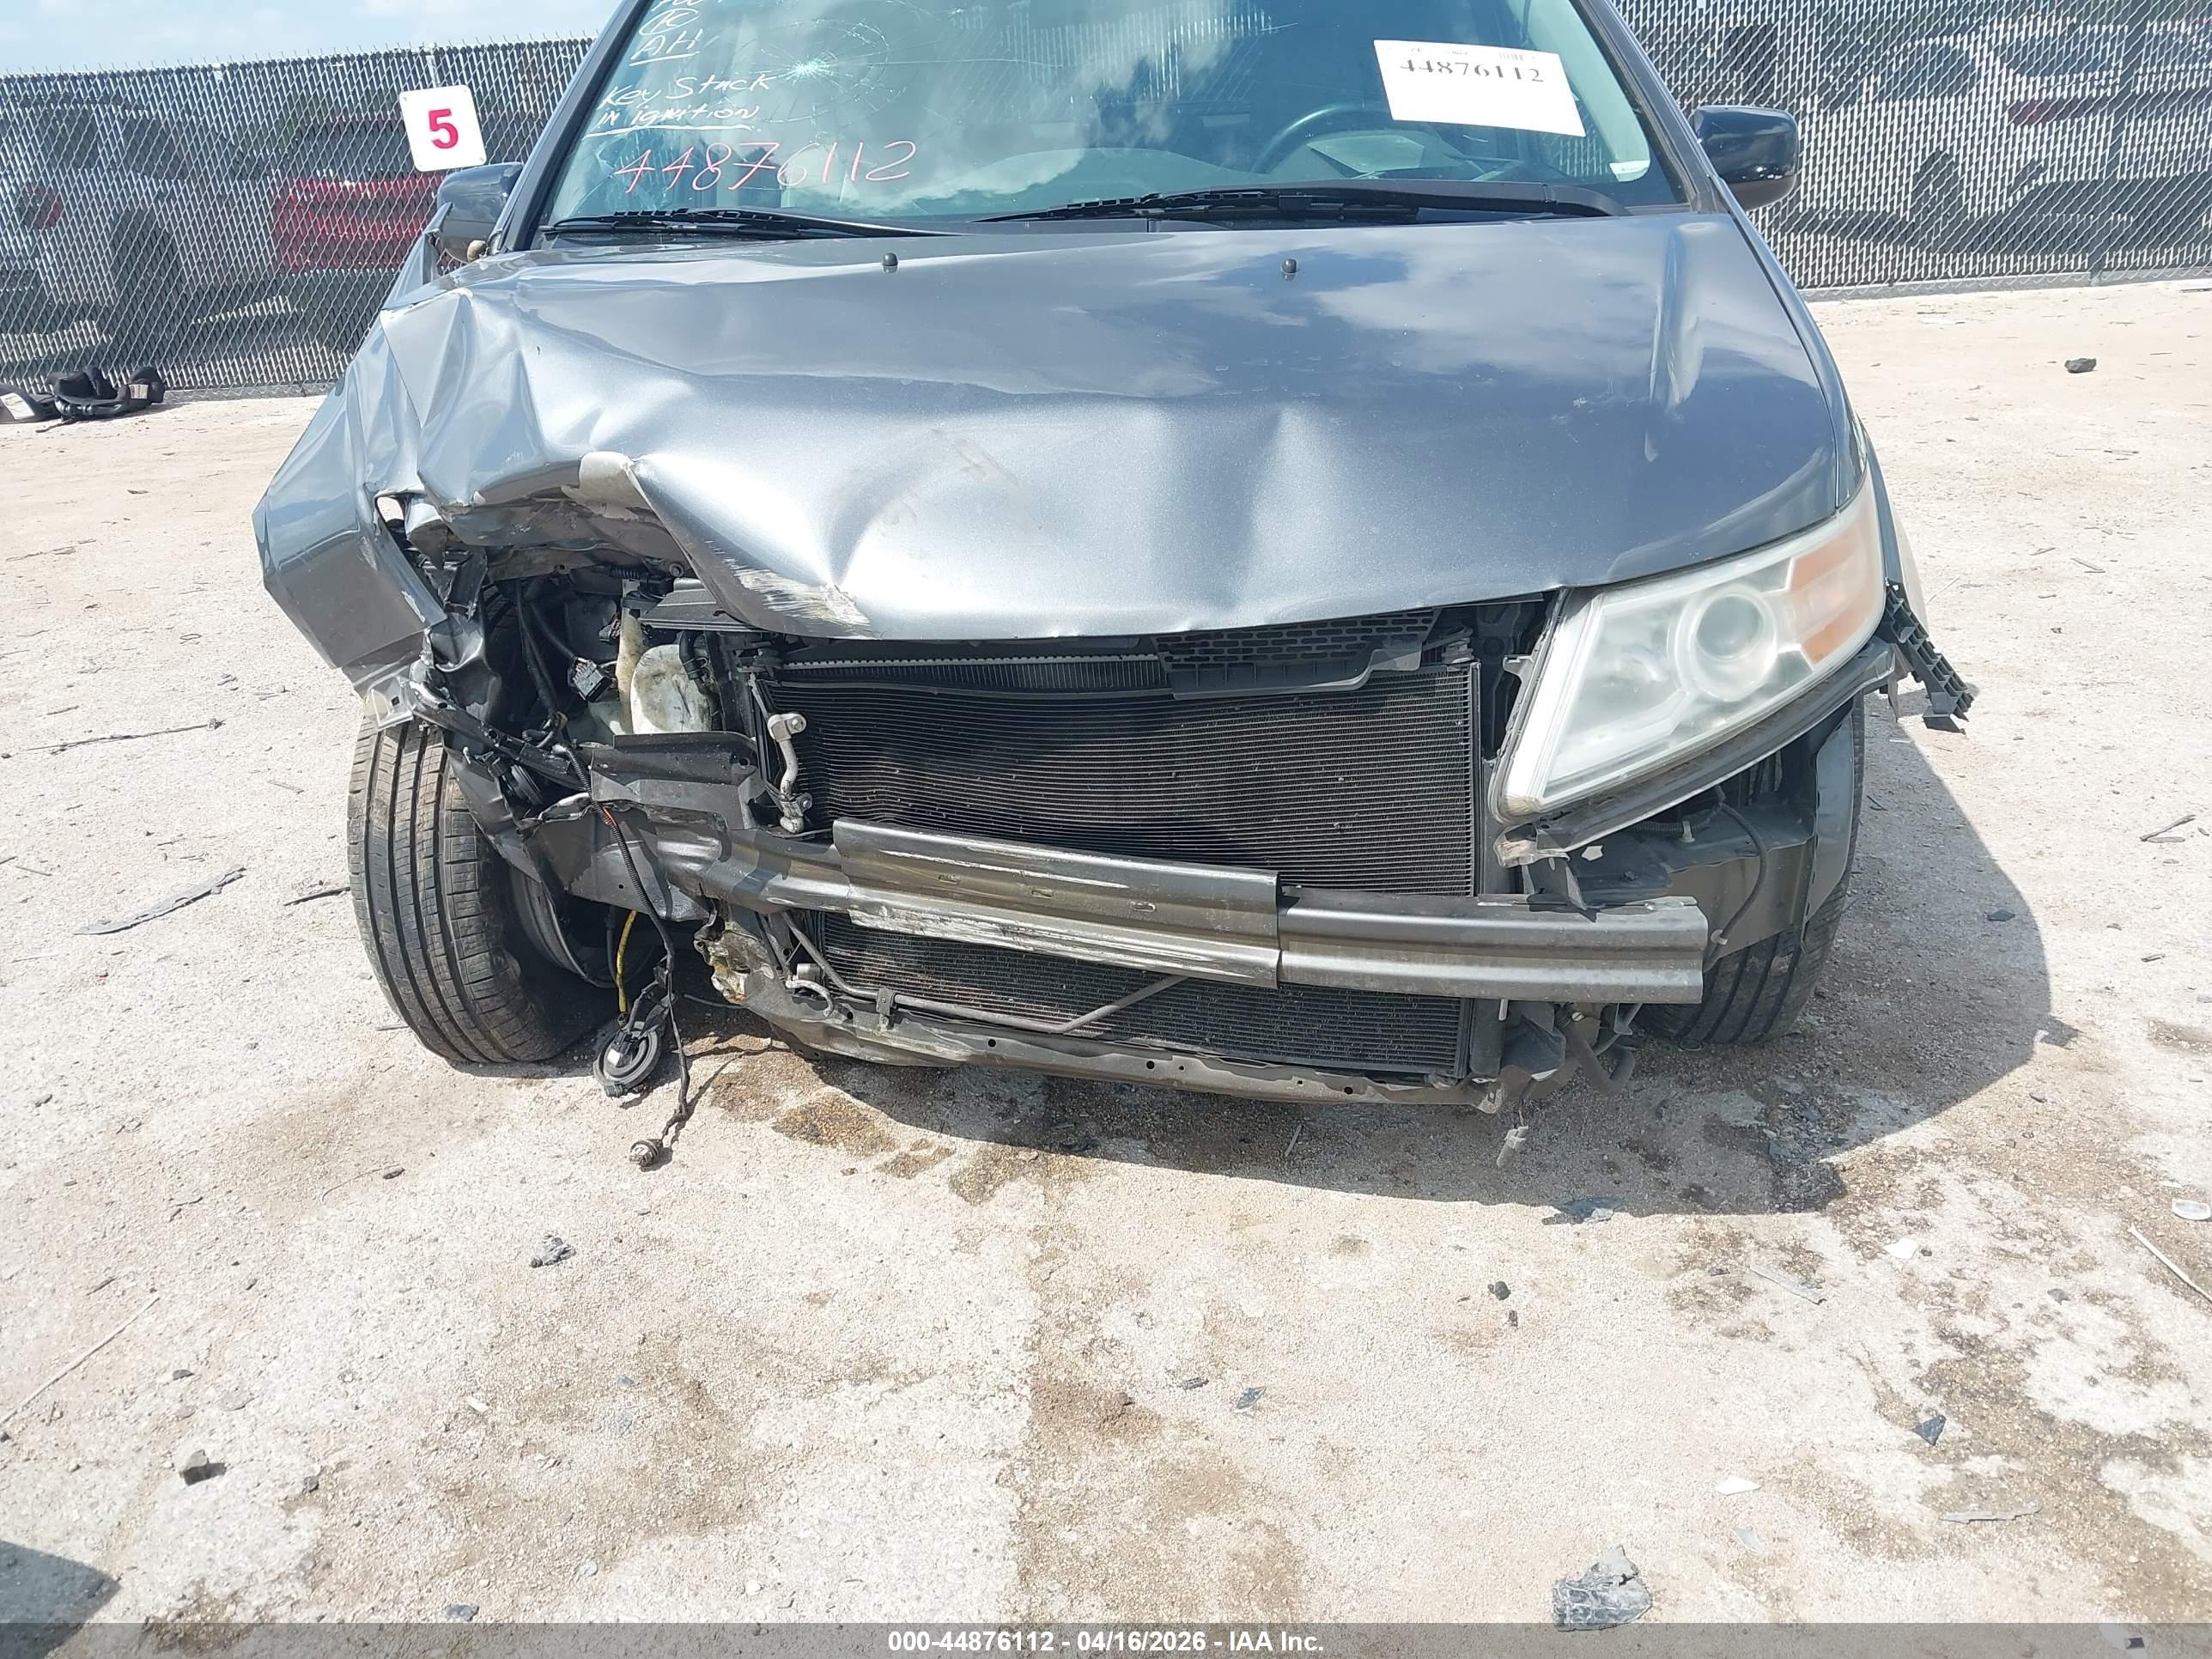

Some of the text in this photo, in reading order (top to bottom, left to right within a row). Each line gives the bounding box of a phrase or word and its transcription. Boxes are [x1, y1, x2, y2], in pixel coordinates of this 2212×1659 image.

[1400, 58, 1544, 82] 44876112
[428, 108, 459, 149] 5
[614, 141, 916, 193] 44876112
